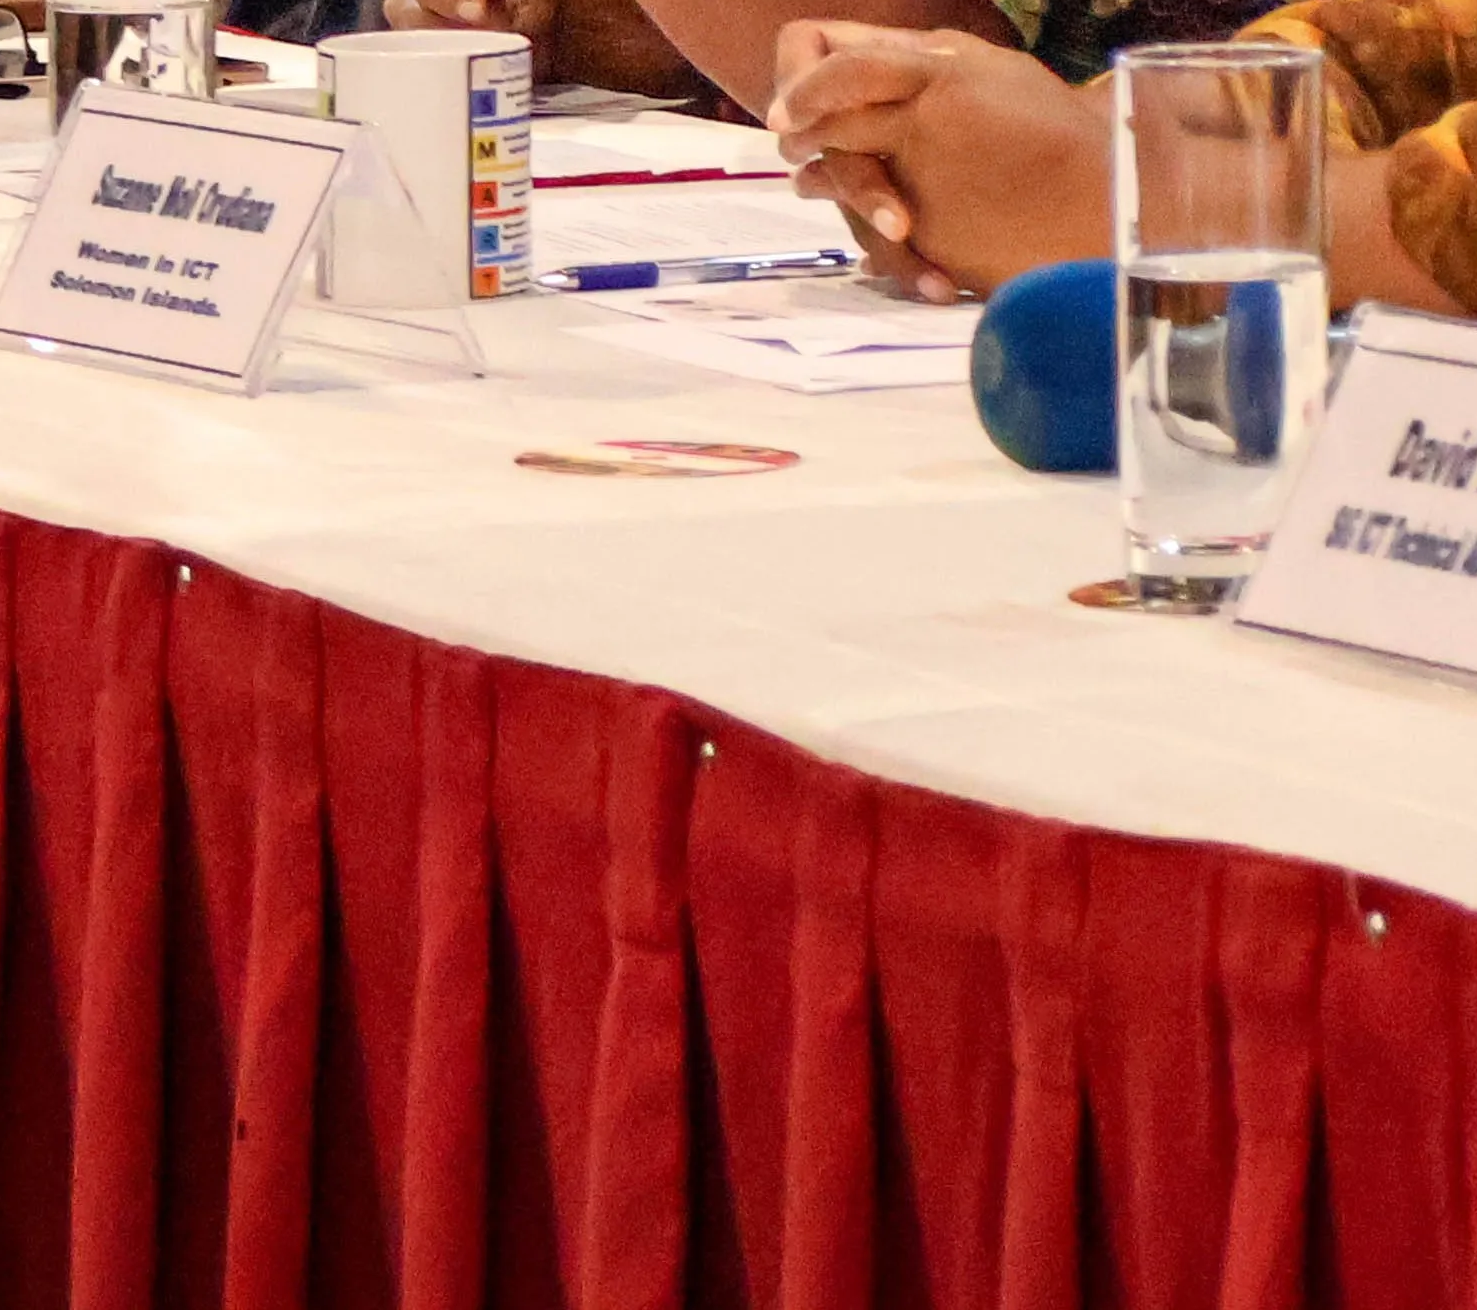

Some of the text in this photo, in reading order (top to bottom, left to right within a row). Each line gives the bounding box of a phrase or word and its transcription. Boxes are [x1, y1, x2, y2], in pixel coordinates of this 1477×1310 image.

[478, 141, 497, 159] M
[78, 240, 150, 270] Women
[179, 258, 220, 281] ICT
[50, 269, 221, 317] Solomon Islands.
